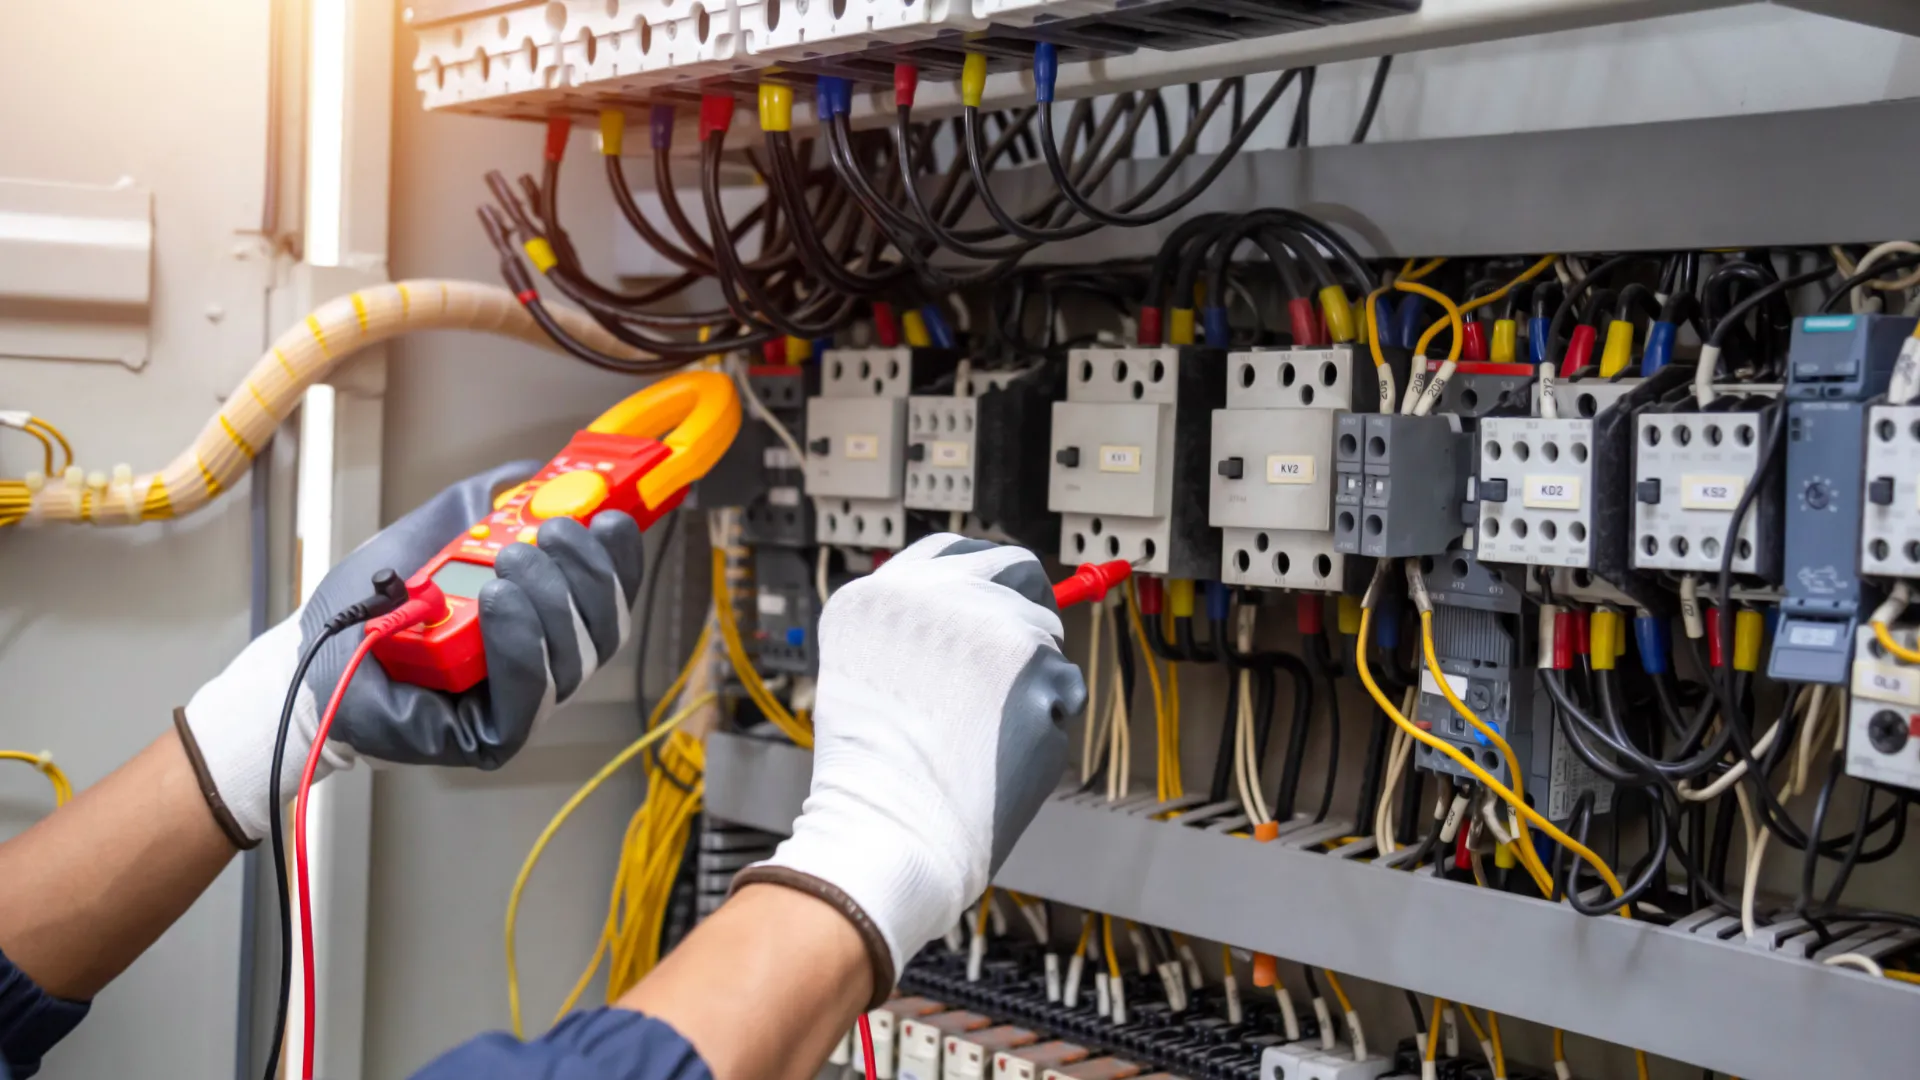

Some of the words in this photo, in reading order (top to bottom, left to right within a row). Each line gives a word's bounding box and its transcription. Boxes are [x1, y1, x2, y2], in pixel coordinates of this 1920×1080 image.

[1281, 464, 1298, 474] KV2
[1541, 485, 1563, 496] KD2
[1702, 487, 1727, 498] KS2
